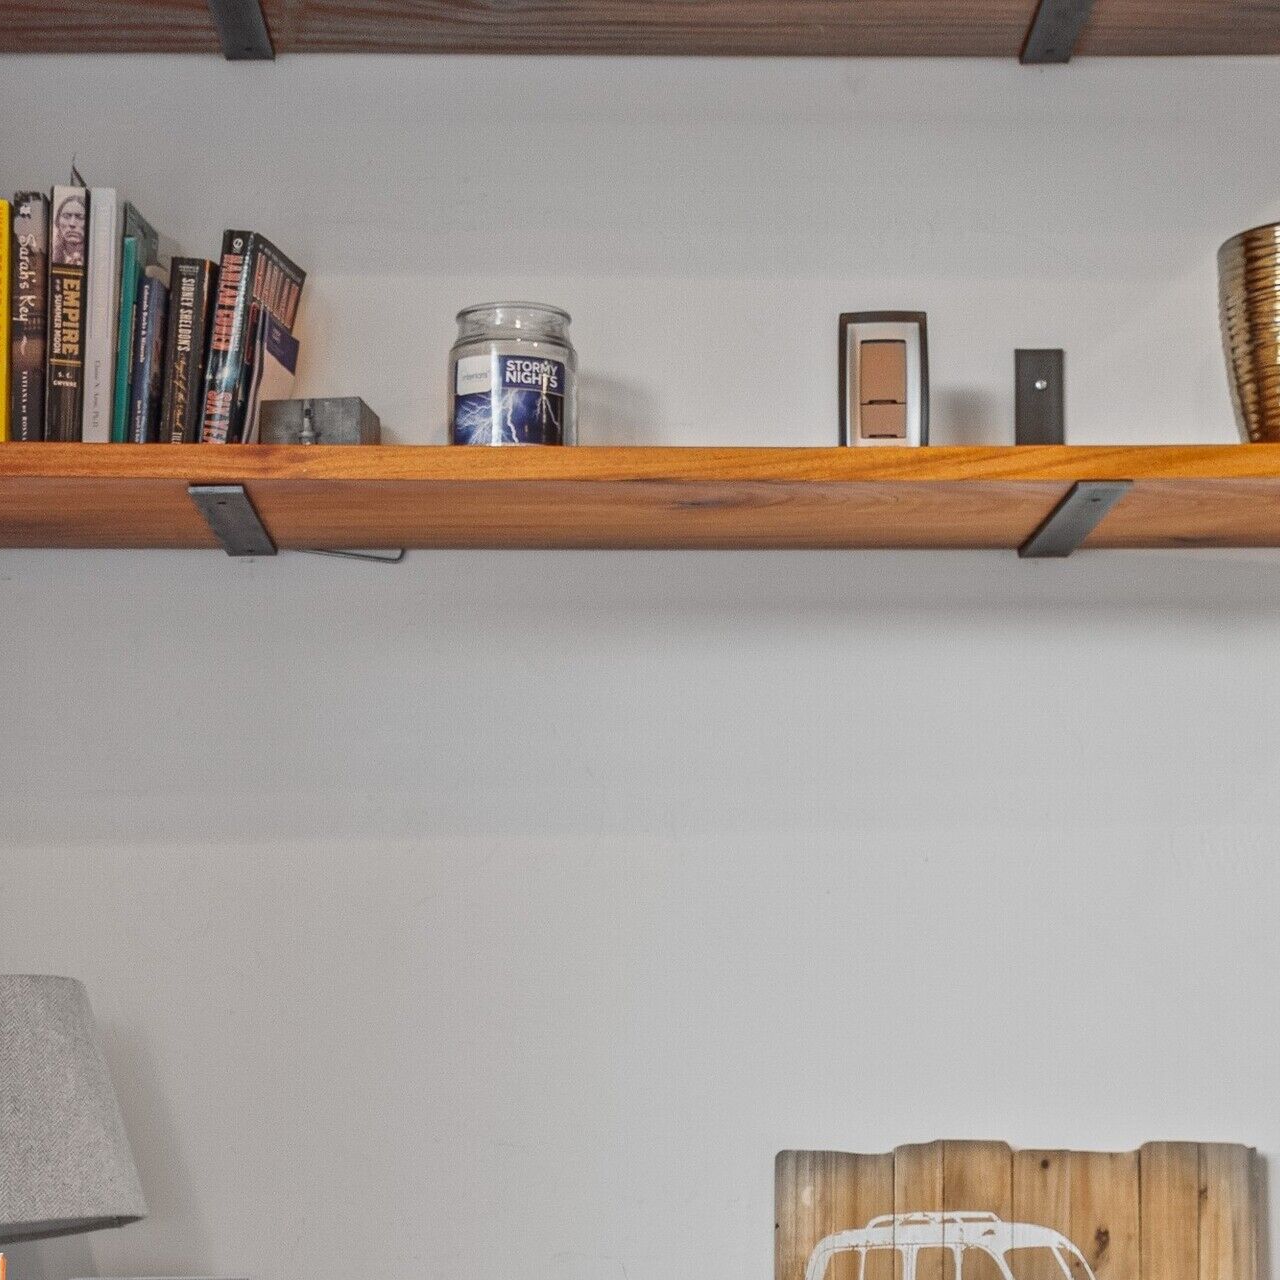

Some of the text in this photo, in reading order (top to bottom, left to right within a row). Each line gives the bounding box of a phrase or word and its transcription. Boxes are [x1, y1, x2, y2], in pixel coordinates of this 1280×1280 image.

[12, 233, 38, 322] Sarah's Key
[180, 278, 196, 307] SIDNEY
[53, 294, 63, 328] SUMMER
[61, 278, 81, 356] EMPIRE
[52, 329, 62, 354] MOON
[177, 308, 193, 352] SHELDON'S
[505, 371, 558, 388] NIGHTS
[506, 360, 558, 376] STORMY
[21, 370, 29, 403] TATIANA
